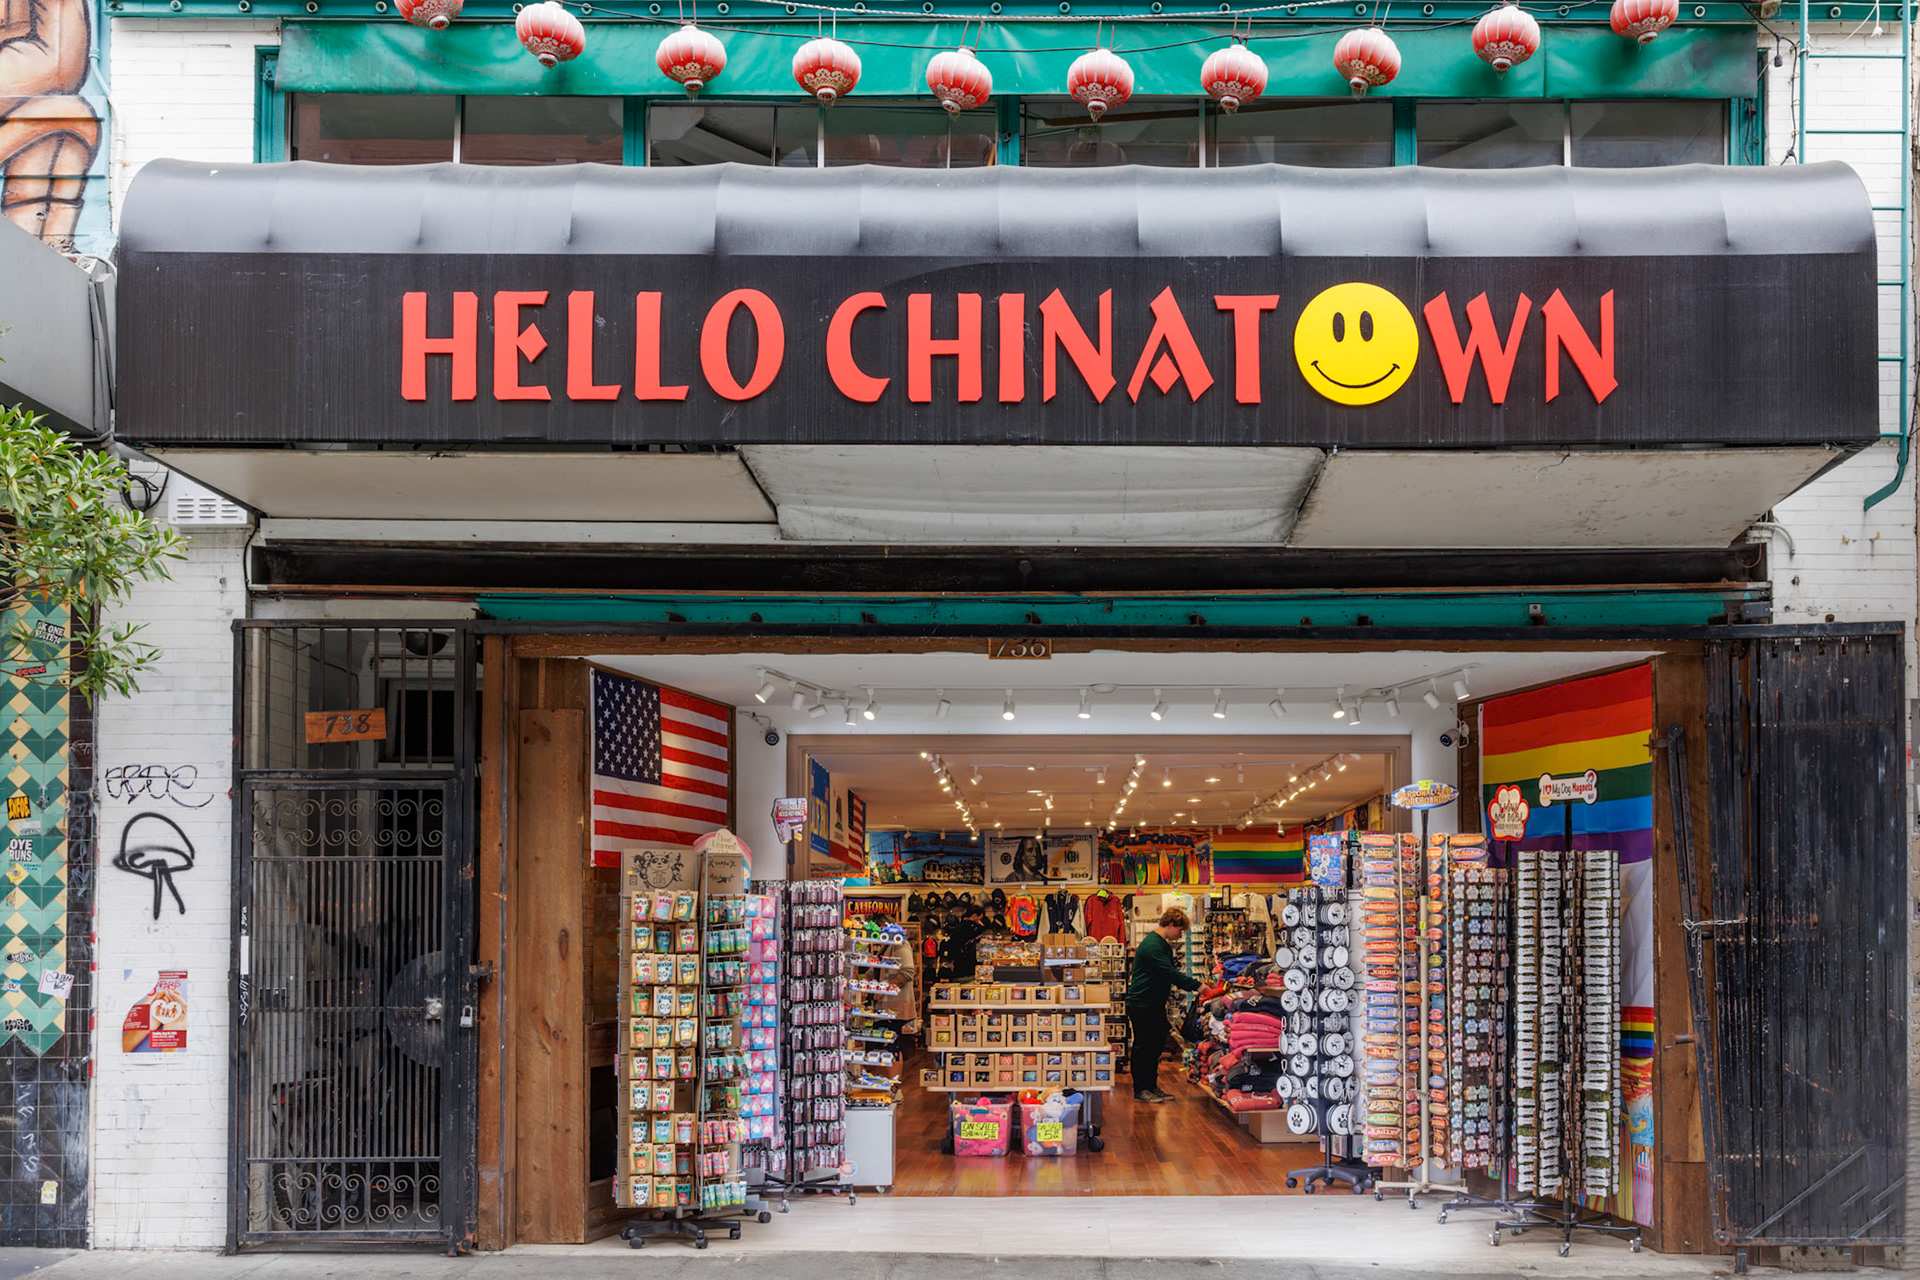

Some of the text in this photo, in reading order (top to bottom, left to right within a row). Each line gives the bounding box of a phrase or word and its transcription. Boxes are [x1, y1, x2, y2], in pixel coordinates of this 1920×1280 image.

[401, 289, 785, 402] HELLO
[48, 625, 65, 636] ONE
[325, 713, 371, 737] 738
[1552, 783, 1561, 798] My
[1561, 782, 1571, 797] Dog
[1572, 782, 1593, 795] Magnets
[10, 838, 33, 850] OYE
[1114, 833, 1196, 848] CALIFORNIA
[10, 849, 33, 861] RUNS
[848, 901, 900, 914] CALIFORNIA
[975, 1122, 998, 1130] SALE
